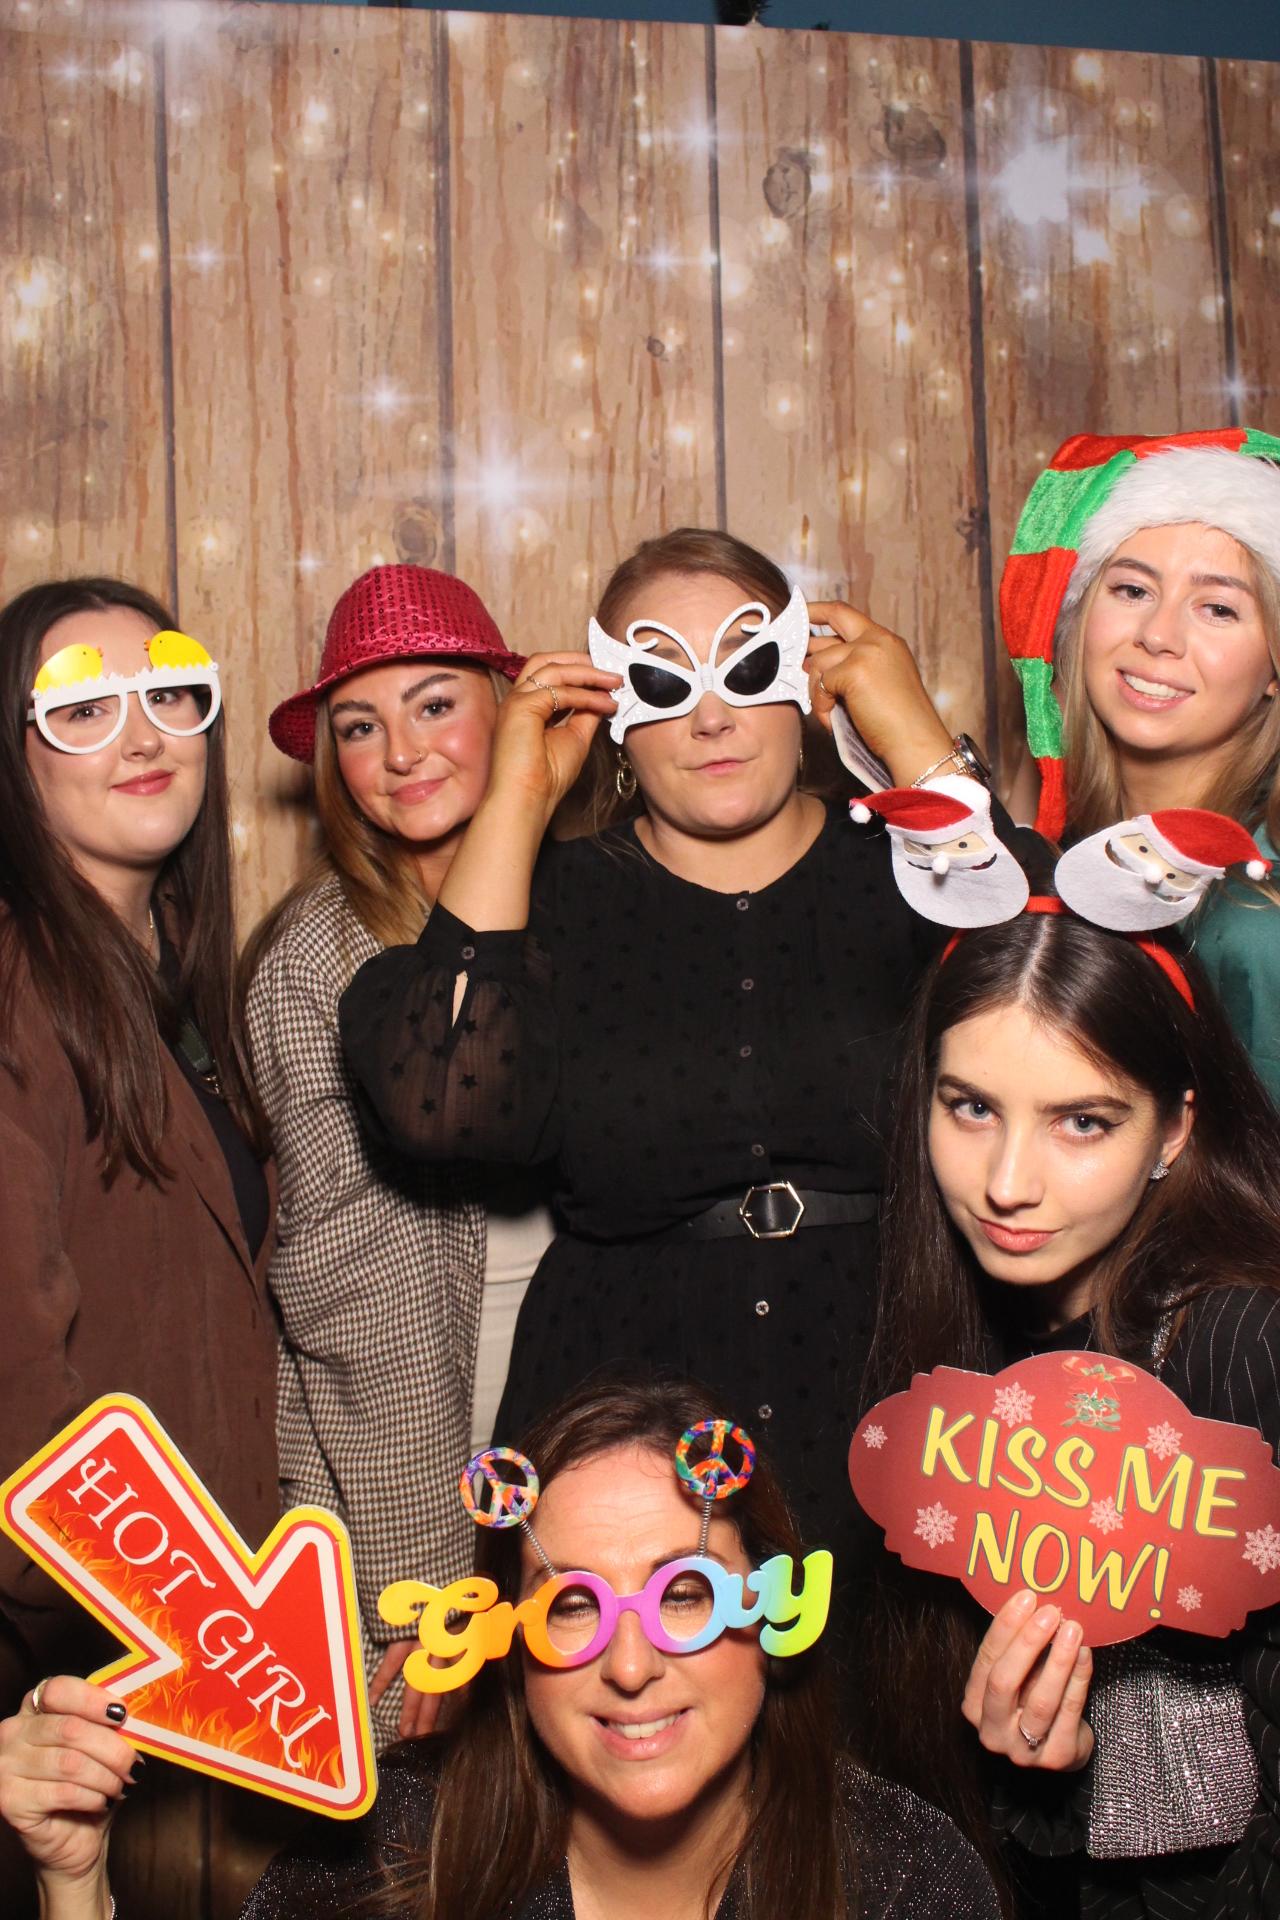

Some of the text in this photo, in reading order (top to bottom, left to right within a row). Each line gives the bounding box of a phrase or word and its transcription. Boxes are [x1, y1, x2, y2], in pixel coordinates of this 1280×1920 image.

[920, 1404, 1248, 1539] KISS ME
[66, 1457, 332, 1769] HOT GIRL
[965, 1508, 1171, 1620] NOW!
